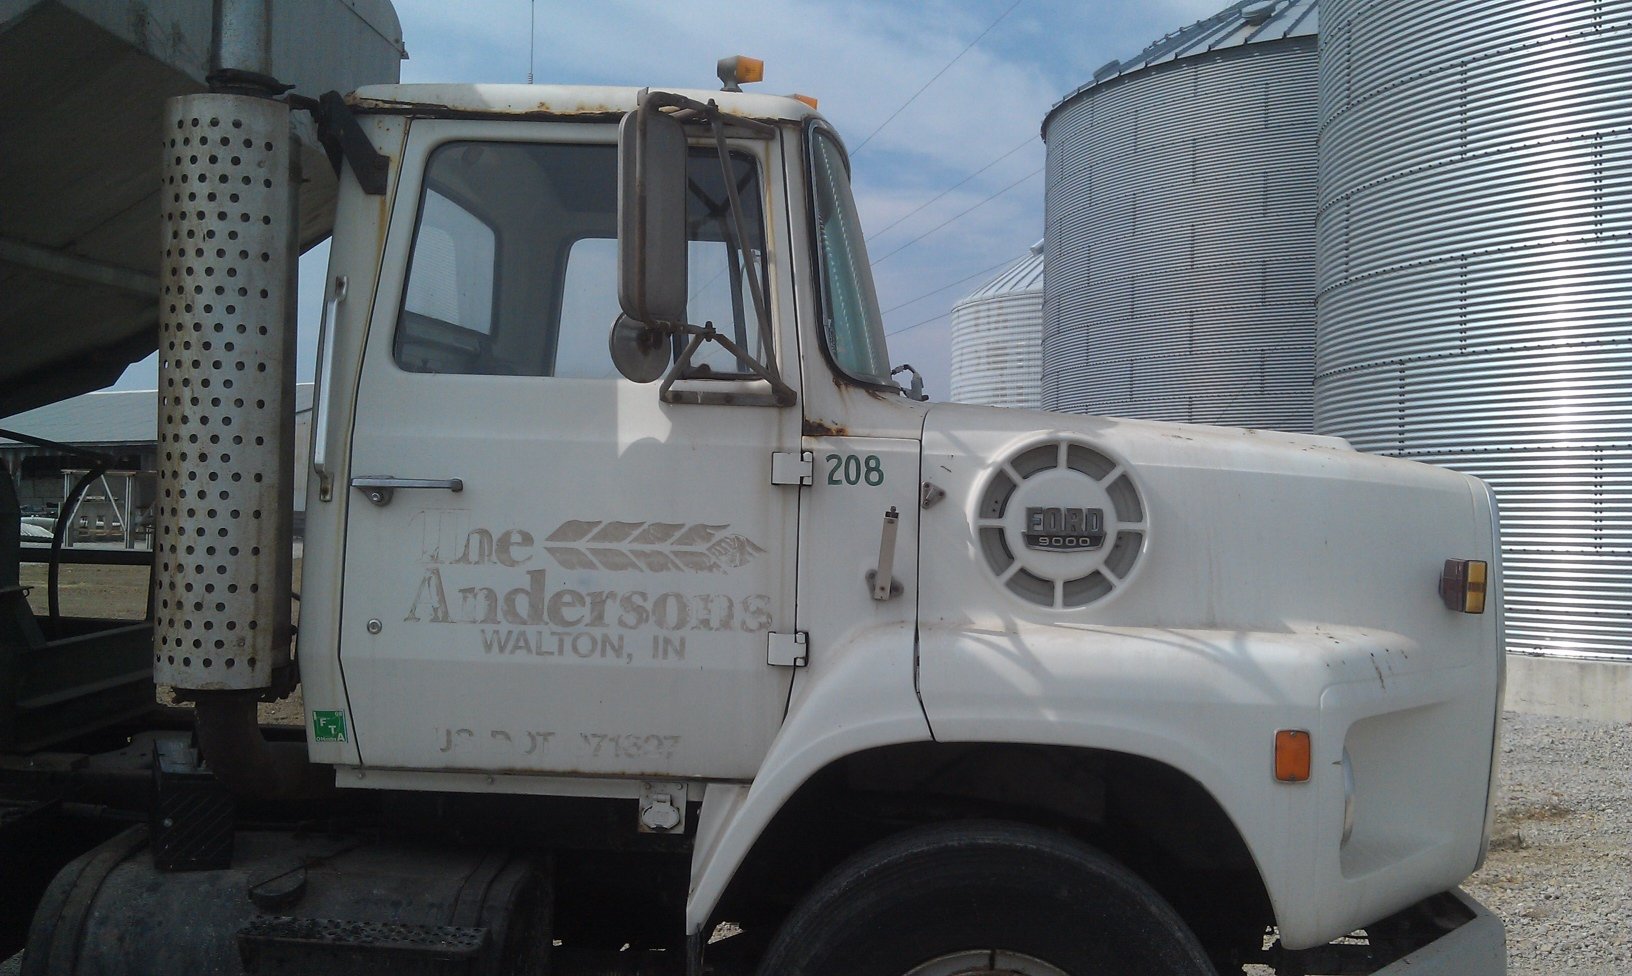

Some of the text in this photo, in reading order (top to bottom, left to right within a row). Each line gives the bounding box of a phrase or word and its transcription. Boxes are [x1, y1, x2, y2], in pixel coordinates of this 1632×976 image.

[825, 453, 884, 487] 208
[1026, 507, 1104, 534] FORD
[1038, 537, 1091, 546] 9000
[403, 567, 773, 633] Andersons
[480, 628, 686, 664] WALTON, IN
